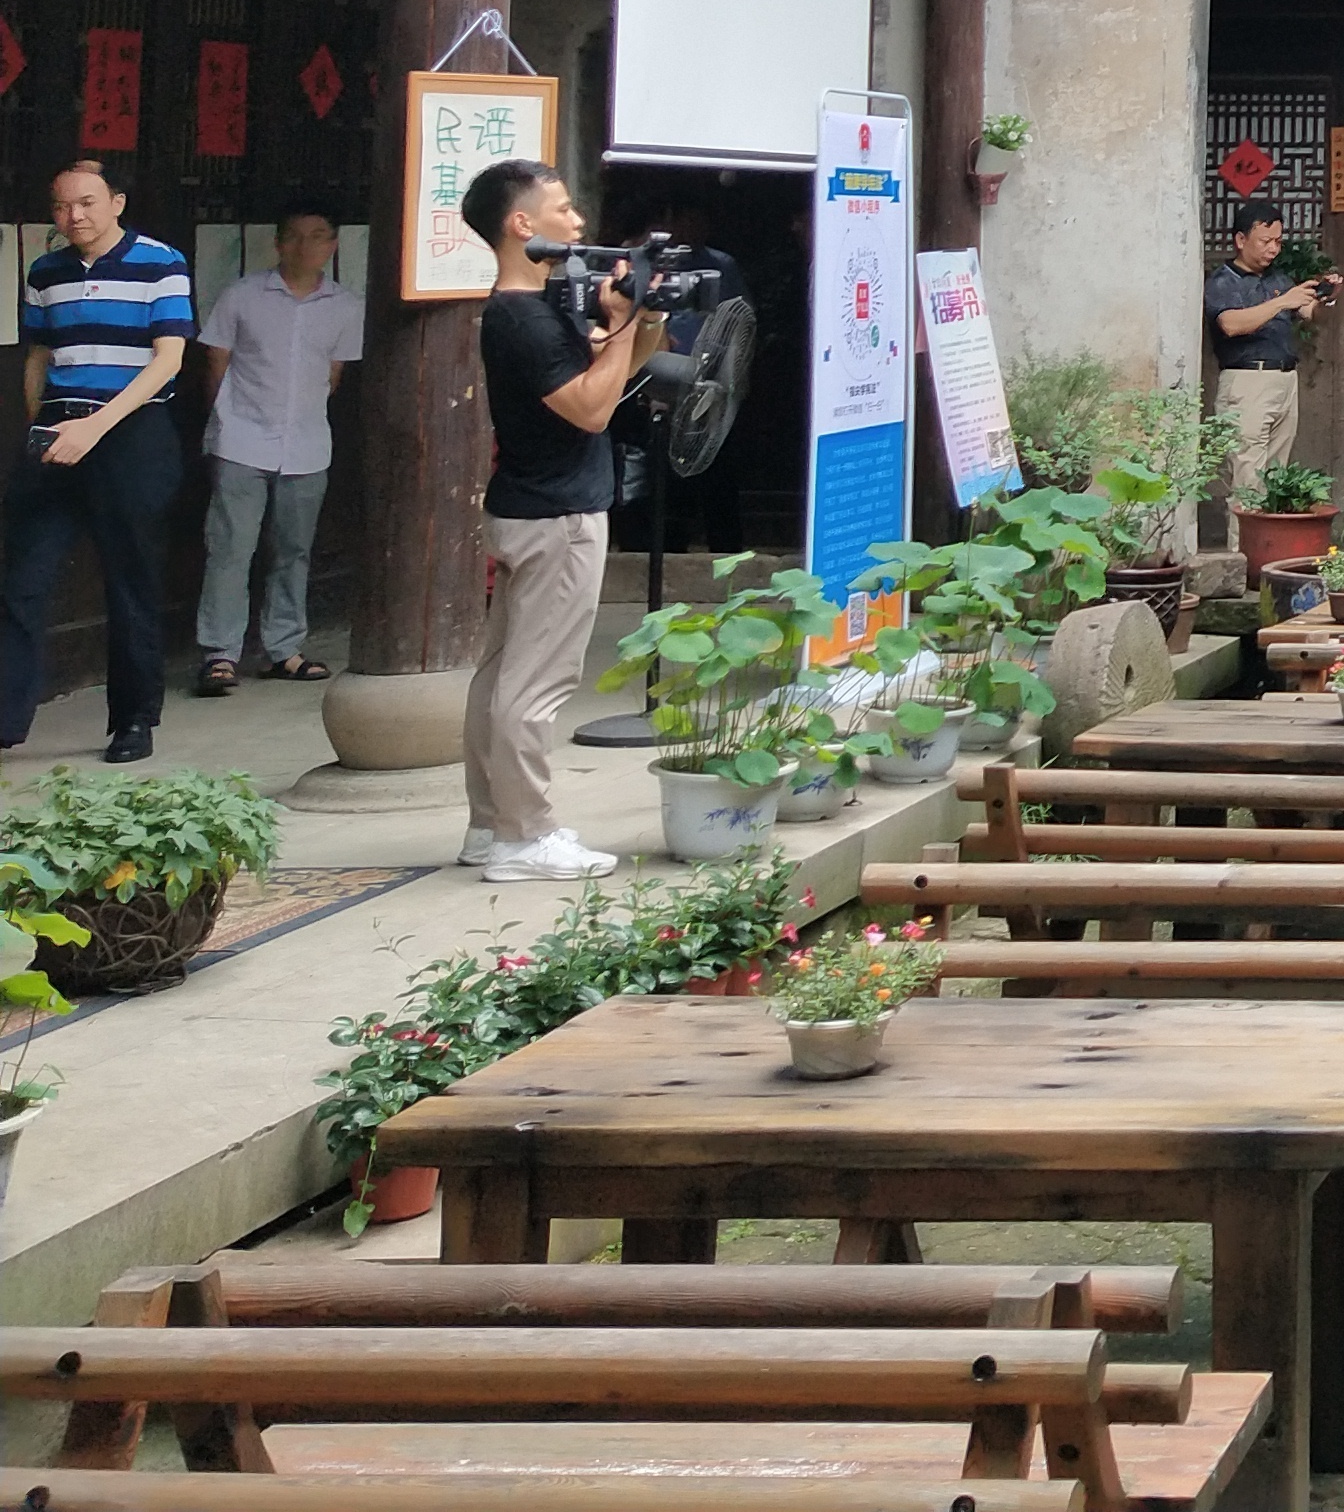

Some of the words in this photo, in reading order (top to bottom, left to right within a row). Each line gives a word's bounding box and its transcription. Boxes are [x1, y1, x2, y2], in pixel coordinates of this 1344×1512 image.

[436, 106, 515, 155] 民谣
[576, 283, 585, 311] SONY
[930, 287, 981, 325] 招募令
